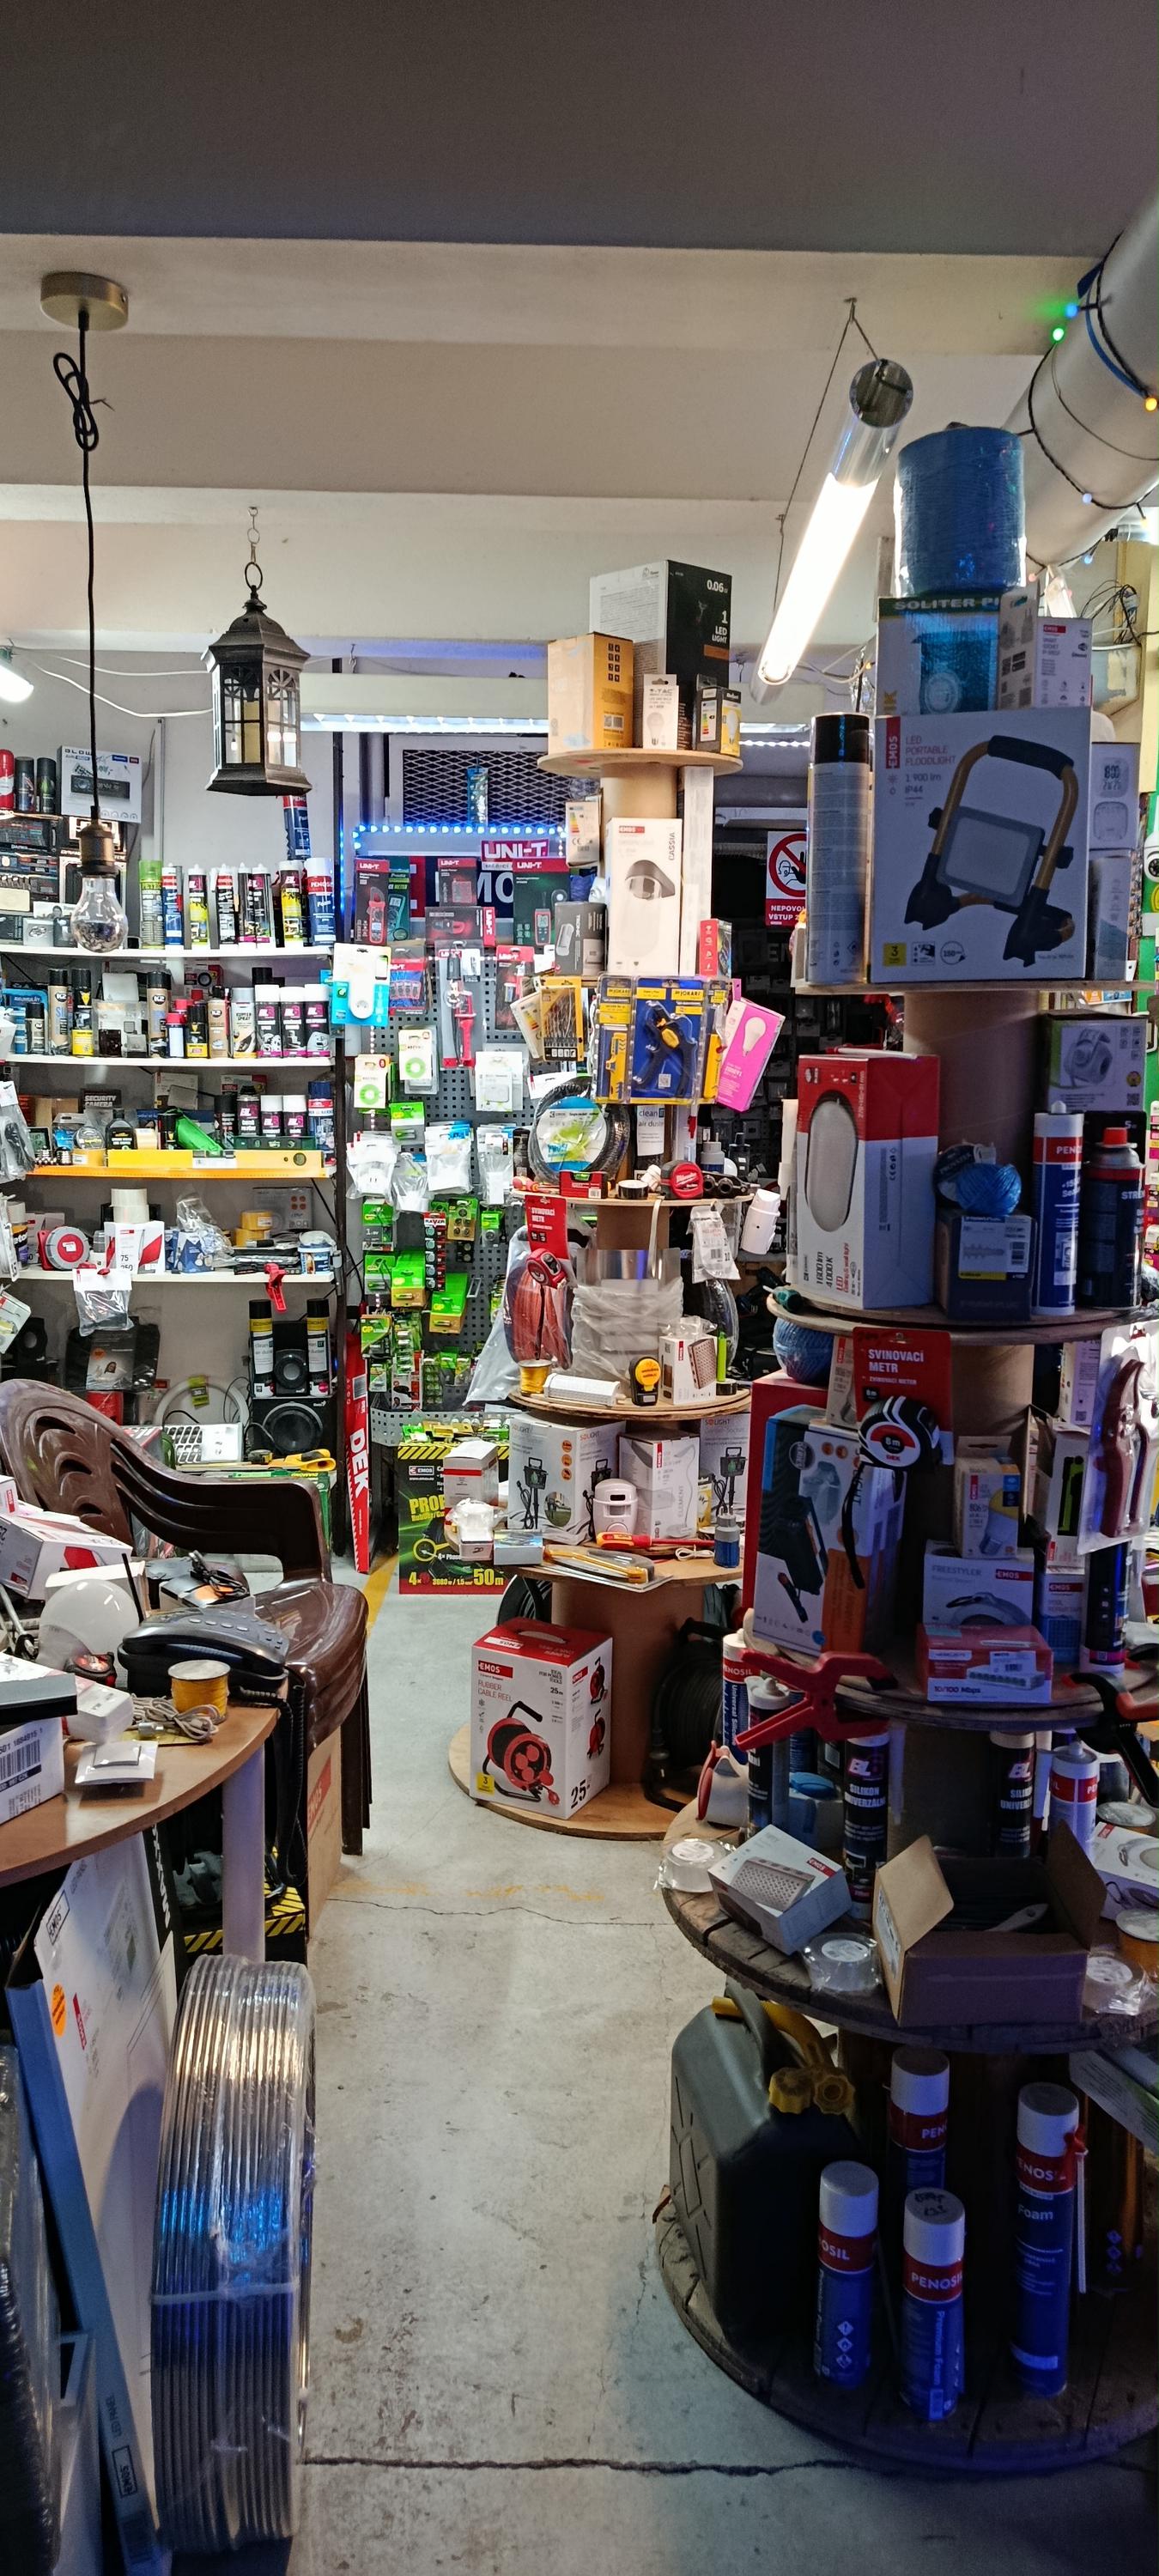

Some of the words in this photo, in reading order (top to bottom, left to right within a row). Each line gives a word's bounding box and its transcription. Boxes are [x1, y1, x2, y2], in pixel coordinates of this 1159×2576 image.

[893, 598, 975, 611] SOLITER
[721, 611, 728, 624] 1
[715, 626, 728, 635] LED
[712, 634, 728, 643] LIGHT
[905, 735, 922, 745] LED
[888, 736, 899, 767] EMOS
[906, 744, 948, 756] PORTABLE
[905, 756, 956, 767] FLOODLIGHT
[905, 785, 923, 794] IP44
[483, 841, 547, 859] UNI-T
[768, 913, 793, 921] VSTUP
[890, 945, 899, 957] 3
[639, 1109, 658, 1117] clean
[868, 1349, 925, 1363] SVINOVACÍ
[869, 1362, 899, 1373] METR
[349, 1428, 368, 1498] DEK
[931, 1565, 982, 1576] FREESTYLER
[997, 1571, 1020, 1579] EMOS
[473, 1568, 495, 1586] 50
[479, 1662, 501, 1674] EMOS
[724, 1665, 753, 1675] ENOSIL
[478, 1680, 502, 1692] RUBBER
[934, 1685, 960, 1693] 10/100
[961, 1686, 981, 1694] Mbps
[477, 1688, 497, 1698] CABLE
[497, 1692, 513, 1702] REEL
[570, 1779, 586, 1809] 25
[849, 1783, 880, 1796] SILIKON
[1017, 2204, 1053, 2221] Foam
[820, 2238, 850, 2262] OSIL
[934, 2311, 945, 2355] Premium
